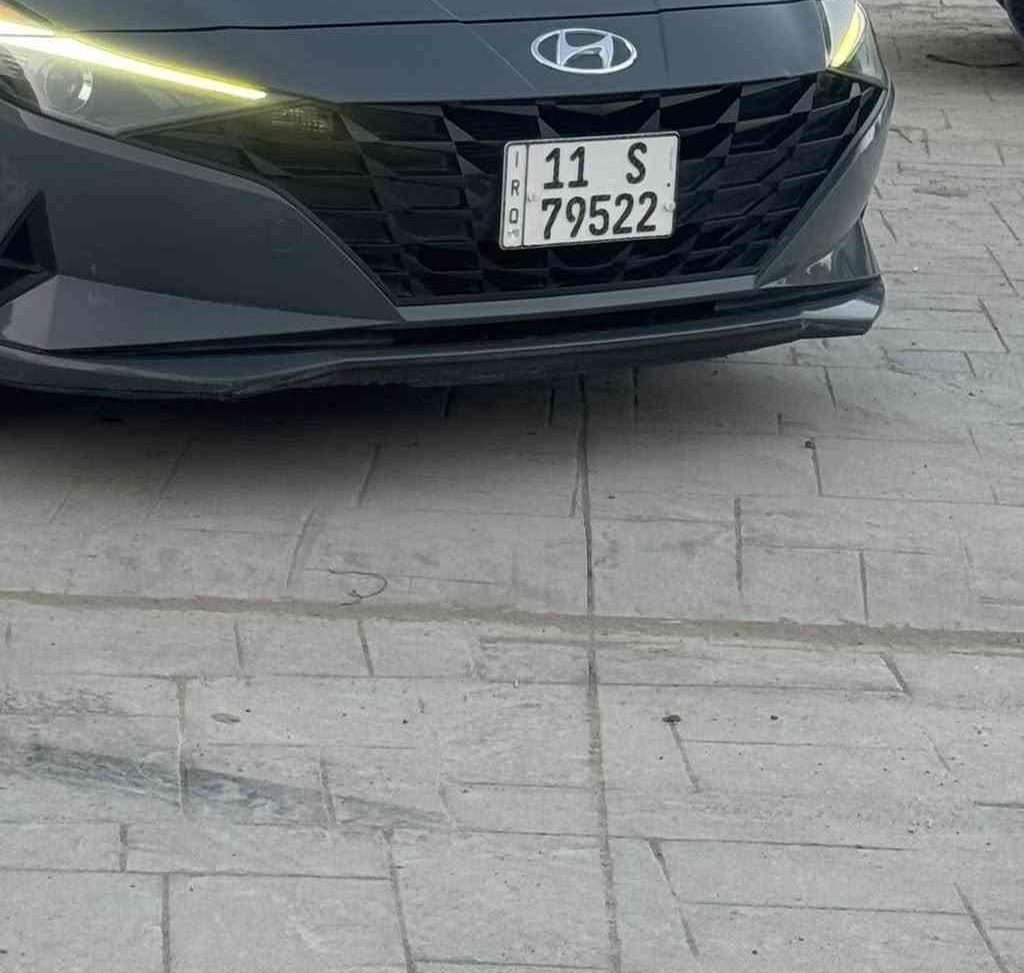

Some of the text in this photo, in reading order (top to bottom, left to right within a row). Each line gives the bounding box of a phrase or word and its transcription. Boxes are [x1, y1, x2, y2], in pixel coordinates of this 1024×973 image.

[543, 142, 648, 190] 11 S
[541, 191, 658, 240] 79522
